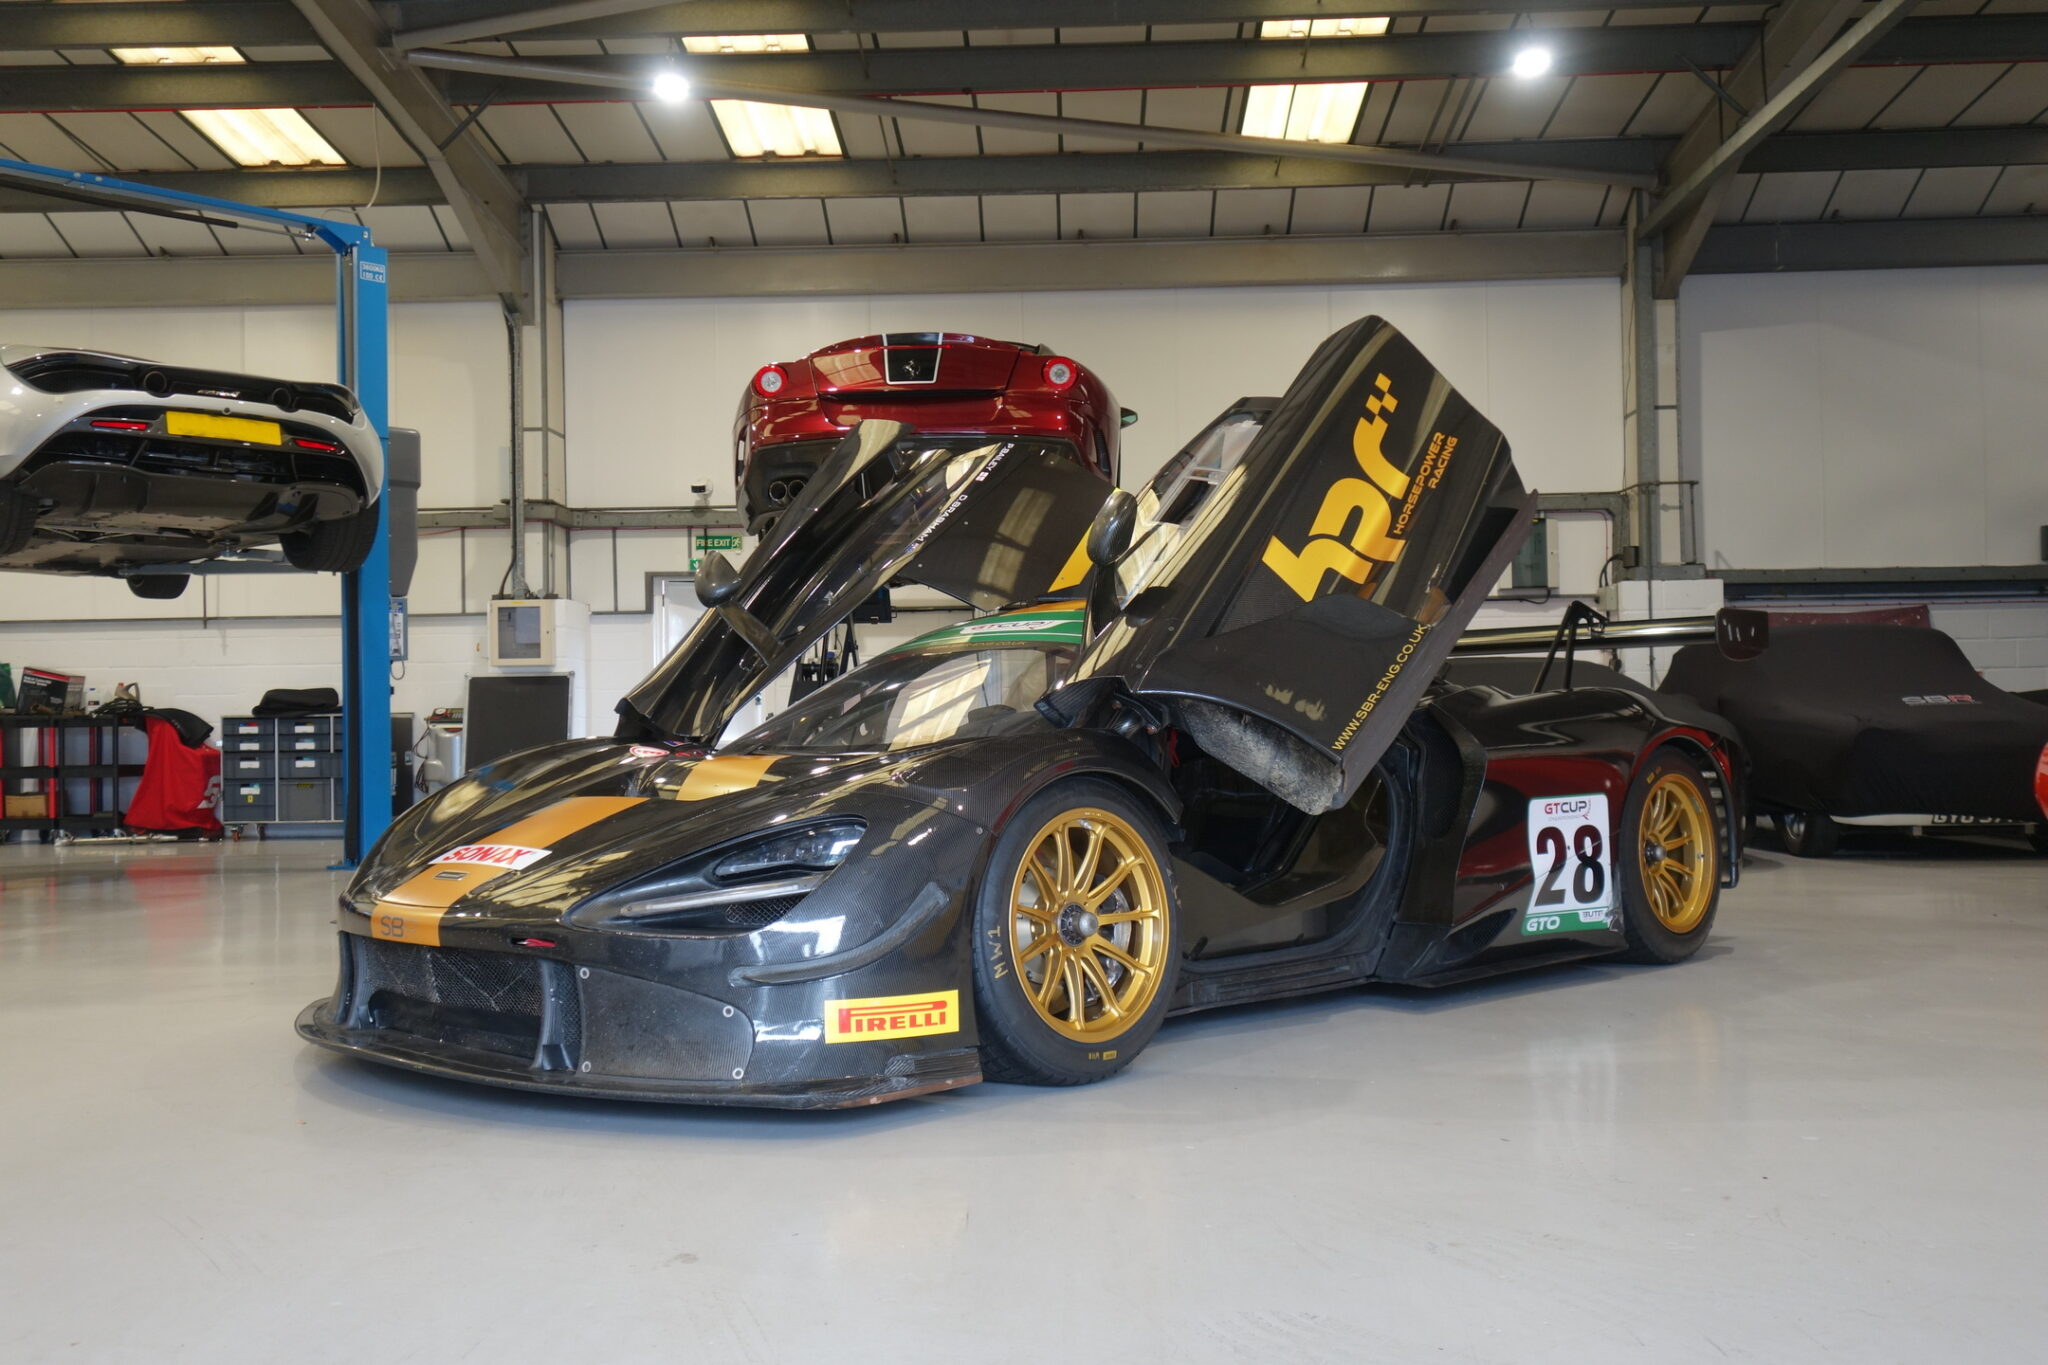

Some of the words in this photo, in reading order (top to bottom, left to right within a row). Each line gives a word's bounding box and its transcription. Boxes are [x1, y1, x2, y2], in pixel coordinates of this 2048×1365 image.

[1428, 436, 1458, 489] RACING
[1393, 431, 1445, 535] HORSEPOWER
[696, 538, 713, 547] FIE
[714, 538, 731, 547] EXIT
[1331, 623, 1429, 751] WWW.SBR-ENG.CO.UK
[1544, 800, 1588, 815] GTCUP
[442, 846, 532, 865] SONAX
[1534, 824, 1605, 907] 28
[1526, 915, 1561, 932] GTO
[838, 1000, 948, 1034] PIRELLI
